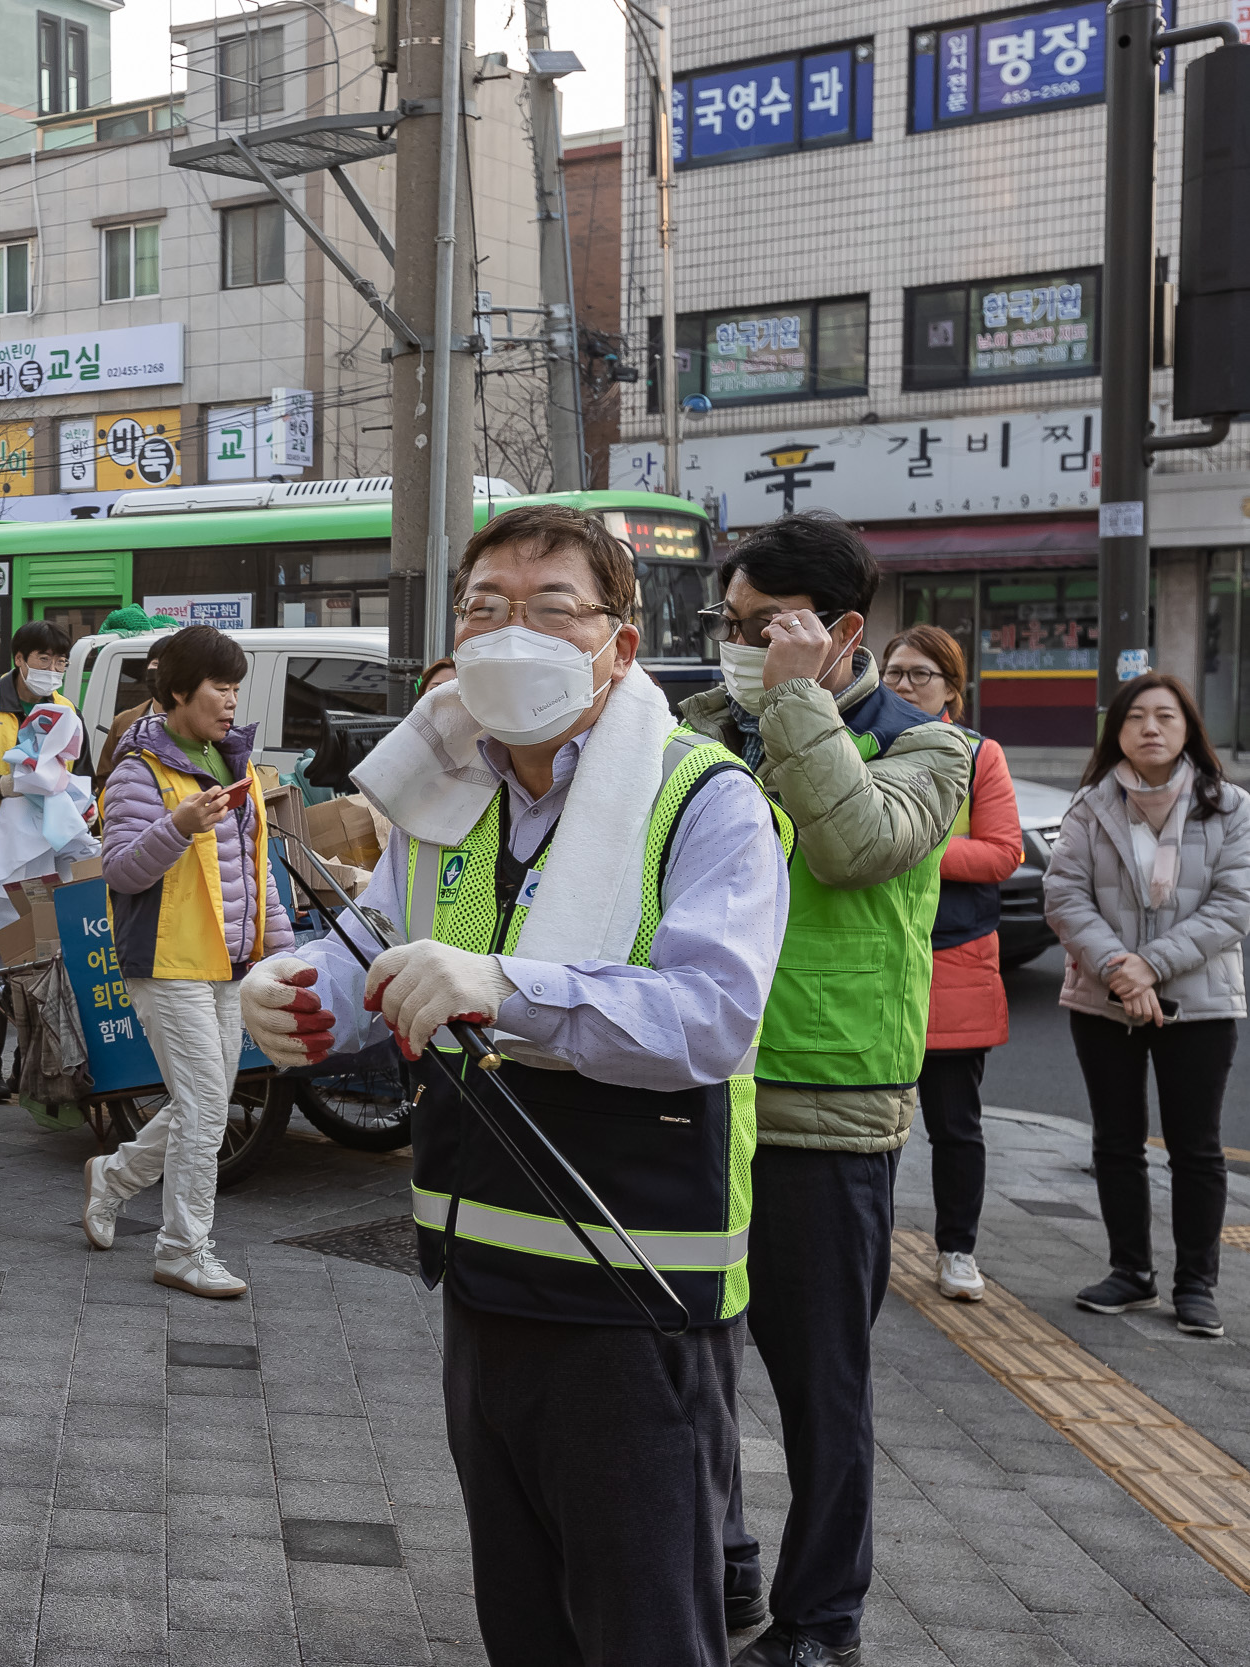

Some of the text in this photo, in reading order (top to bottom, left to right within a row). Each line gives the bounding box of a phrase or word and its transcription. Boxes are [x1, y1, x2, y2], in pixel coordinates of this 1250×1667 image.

[987, 18, 1098, 86] 명장
[947, 34, 968, 112] 입시전문
[1001, 80, 1081, 105] 453-2506
[695, 67, 844, 135] 국영수 과
[983, 284, 1082, 328] 한국기원
[716, 316, 800, 355] 한국기원
[47, 343, 100, 380] 교실
[106, 363, 165, 378] 02)455-1268
[111, 421, 173, 482] 바둑
[887, 415, 1093, 478] 갈비찜
[155, 604, 238, 617] 2023년 광진구 청년
[440, 888, 456, 898] 광진구
[99, 1016, 133, 1043] 함께
